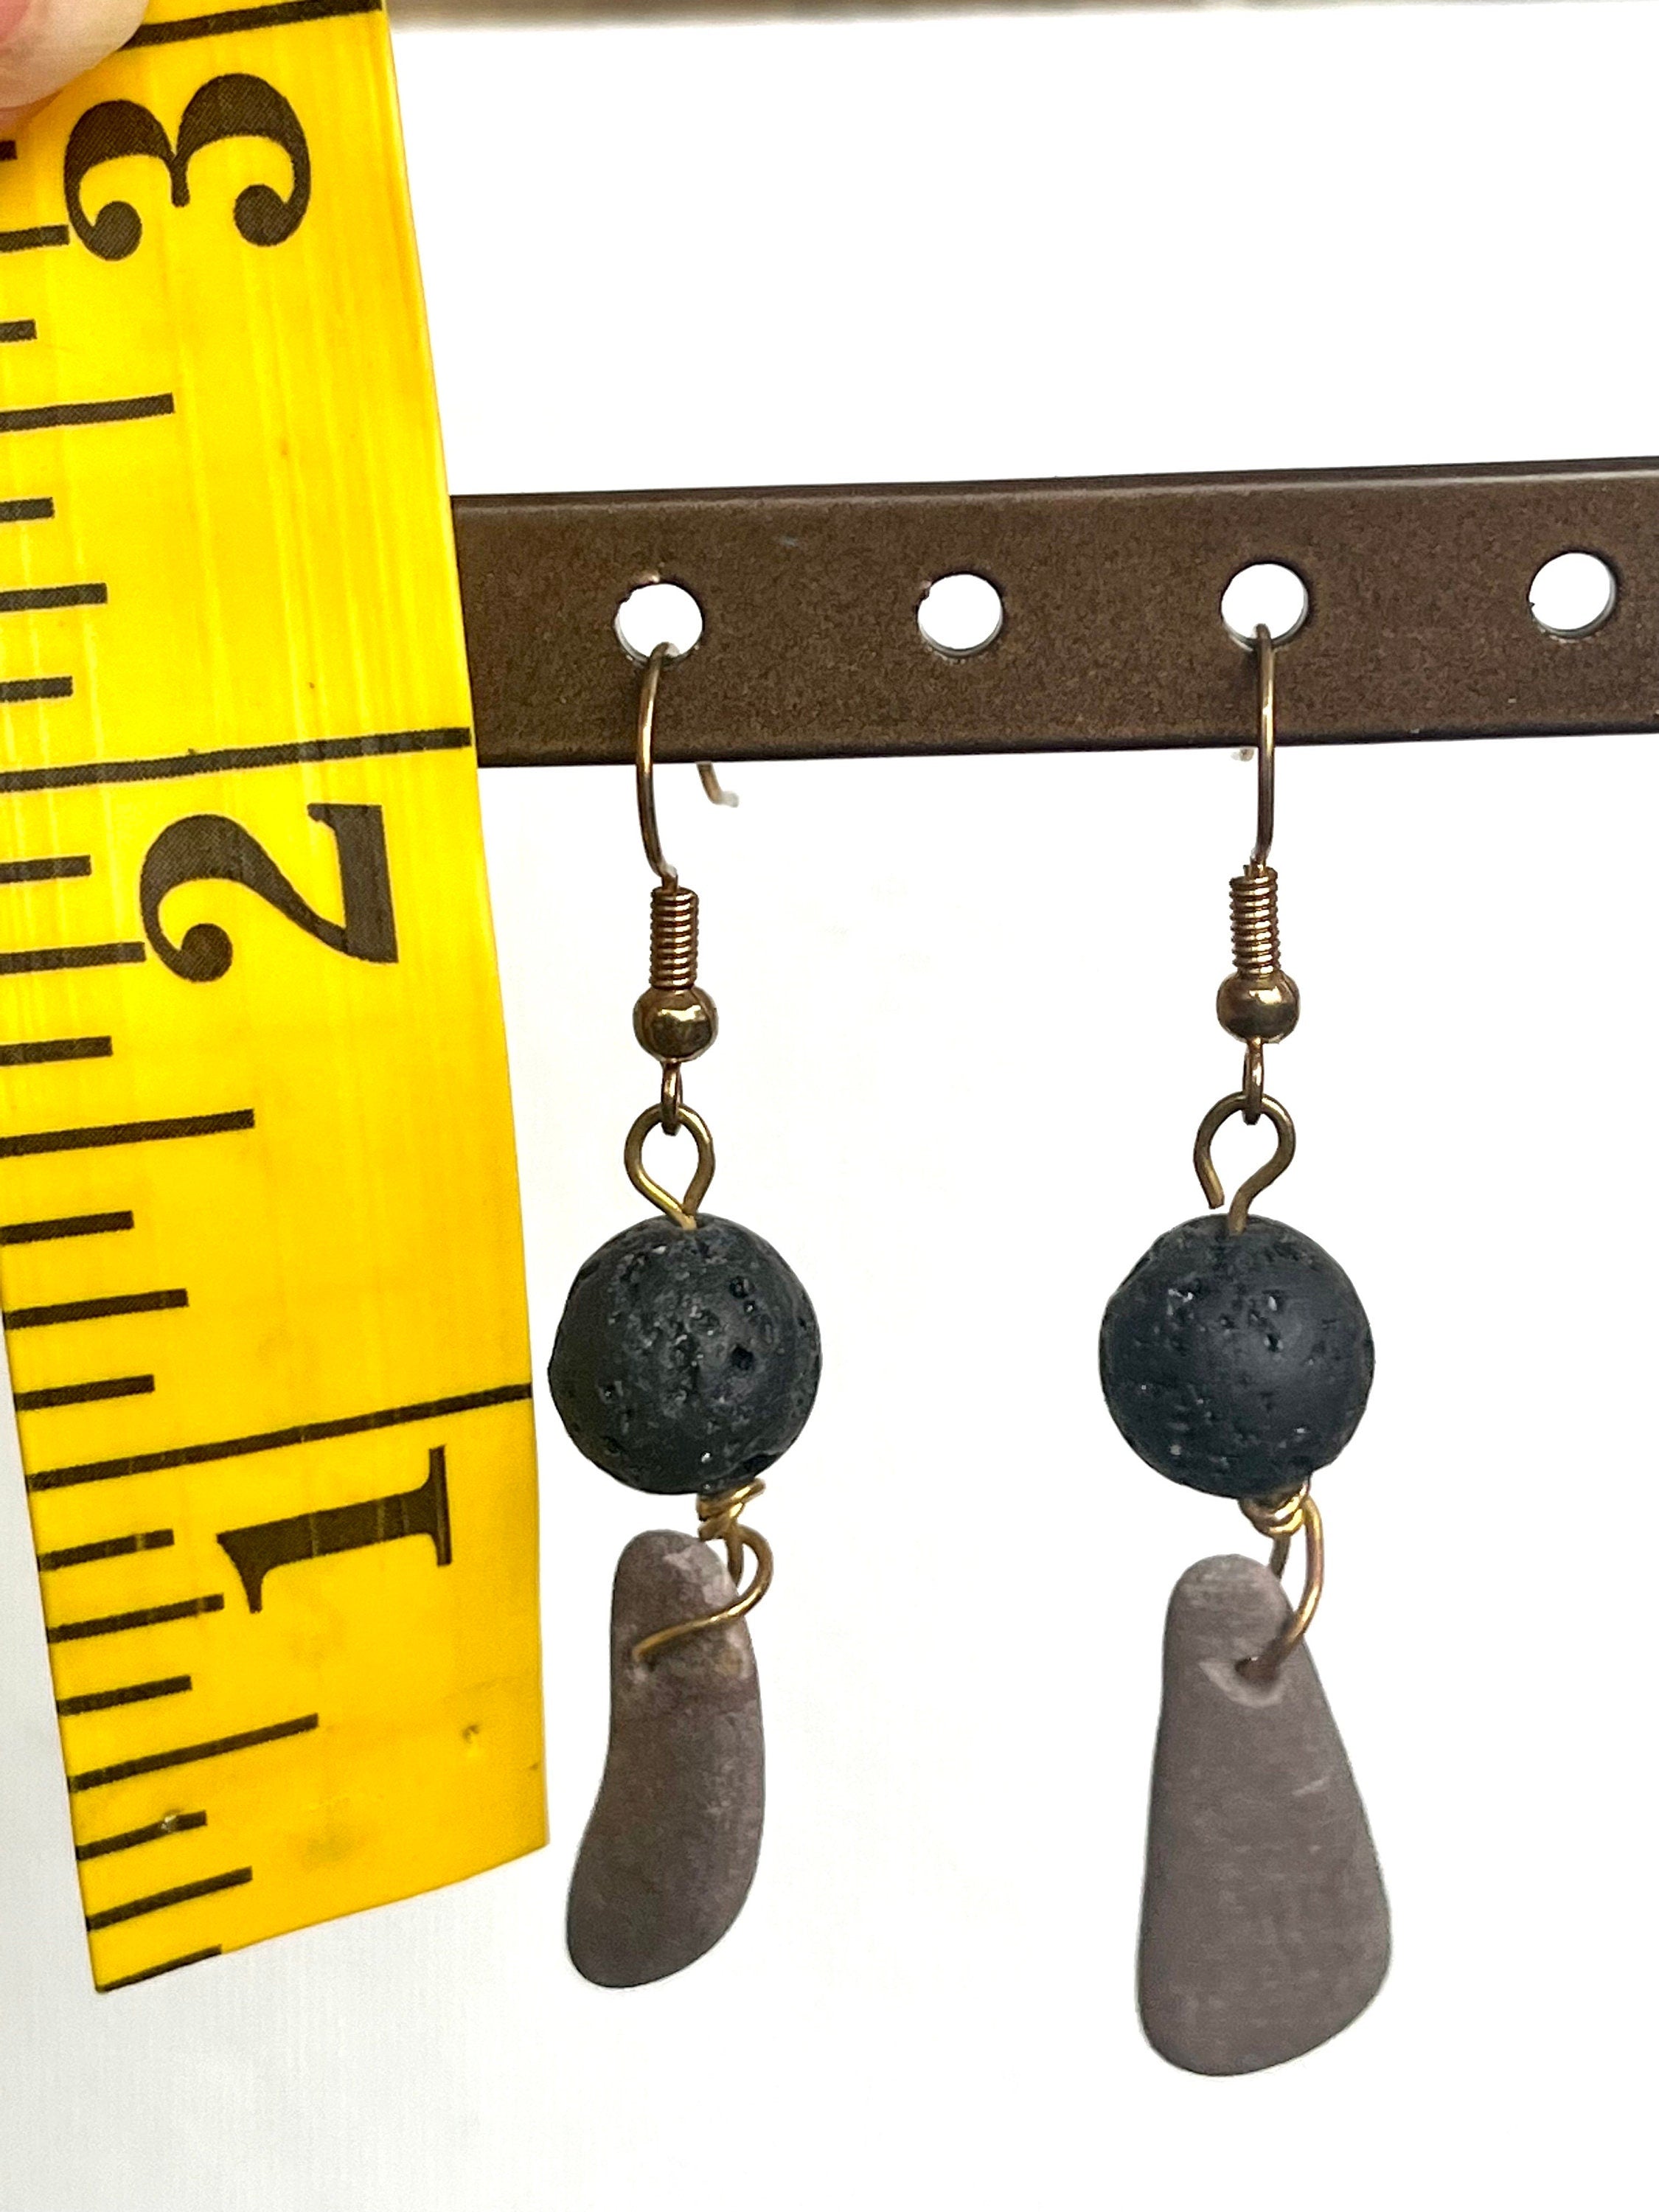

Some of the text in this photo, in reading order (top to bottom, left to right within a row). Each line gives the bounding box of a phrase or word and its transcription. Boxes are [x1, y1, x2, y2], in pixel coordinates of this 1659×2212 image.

[63, 72, 311, 261] 3
[139, 803, 399, 982] 2
[216, 1444, 452, 1613] 1
